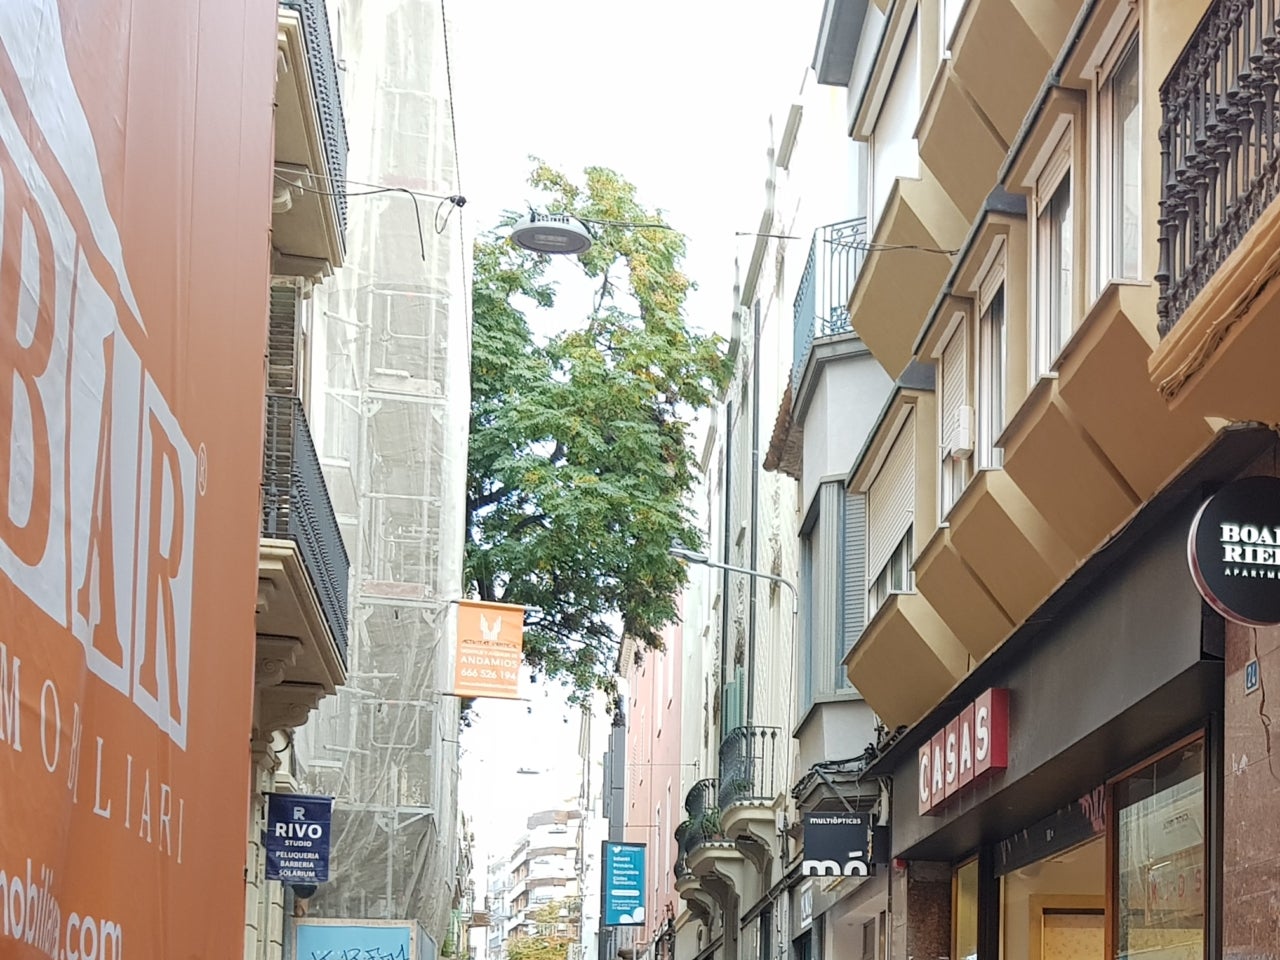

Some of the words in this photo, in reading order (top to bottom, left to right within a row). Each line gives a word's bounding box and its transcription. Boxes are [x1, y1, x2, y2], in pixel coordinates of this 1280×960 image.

[461, 655, 518, 668] ANDAMIOS
[461, 668, 478, 677] 666
[920, 706, 989, 802] CASAS
[275, 823, 323, 839] RIVO
[284, 840, 313, 848] STUDIO
[275, 851, 320, 860] PELUQUERIA
[280, 860, 315, 869] BARBERIA
[278, 869, 316, 878] SOLARIUM
